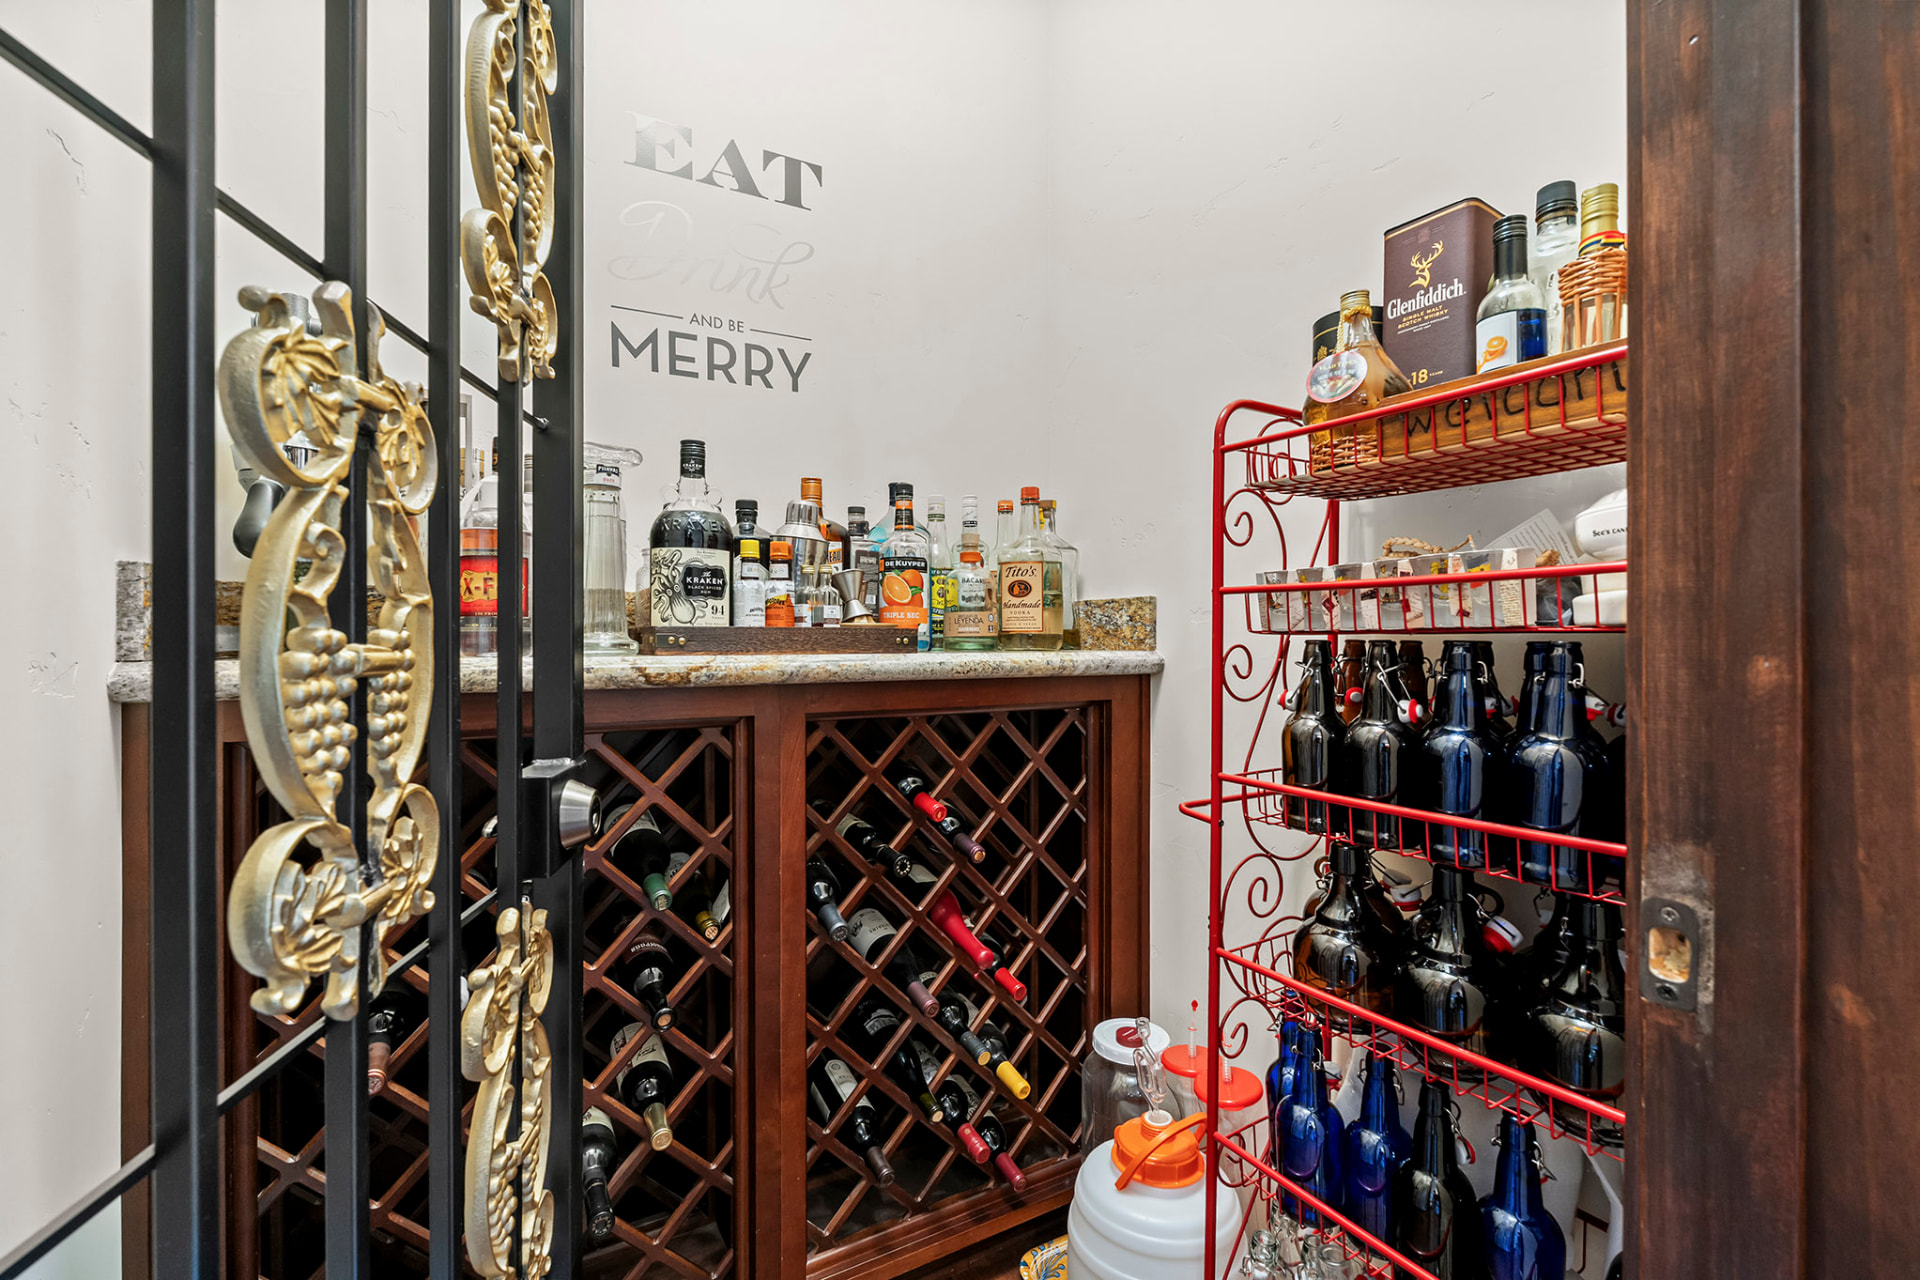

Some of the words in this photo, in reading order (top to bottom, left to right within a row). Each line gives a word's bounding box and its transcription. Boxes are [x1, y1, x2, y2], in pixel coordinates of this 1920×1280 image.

[622, 111, 822, 210] EAT
[1426, 305, 1443, 314] MALT
[689, 313, 723, 329] AND
[728, 319, 744, 333] BE
[611, 321, 812, 392] MERRY
[1411, 369, 1428, 385] 18
[686, 576, 724, 585] KRAKEN
[882, 611, 905, 619] TRIPLE
